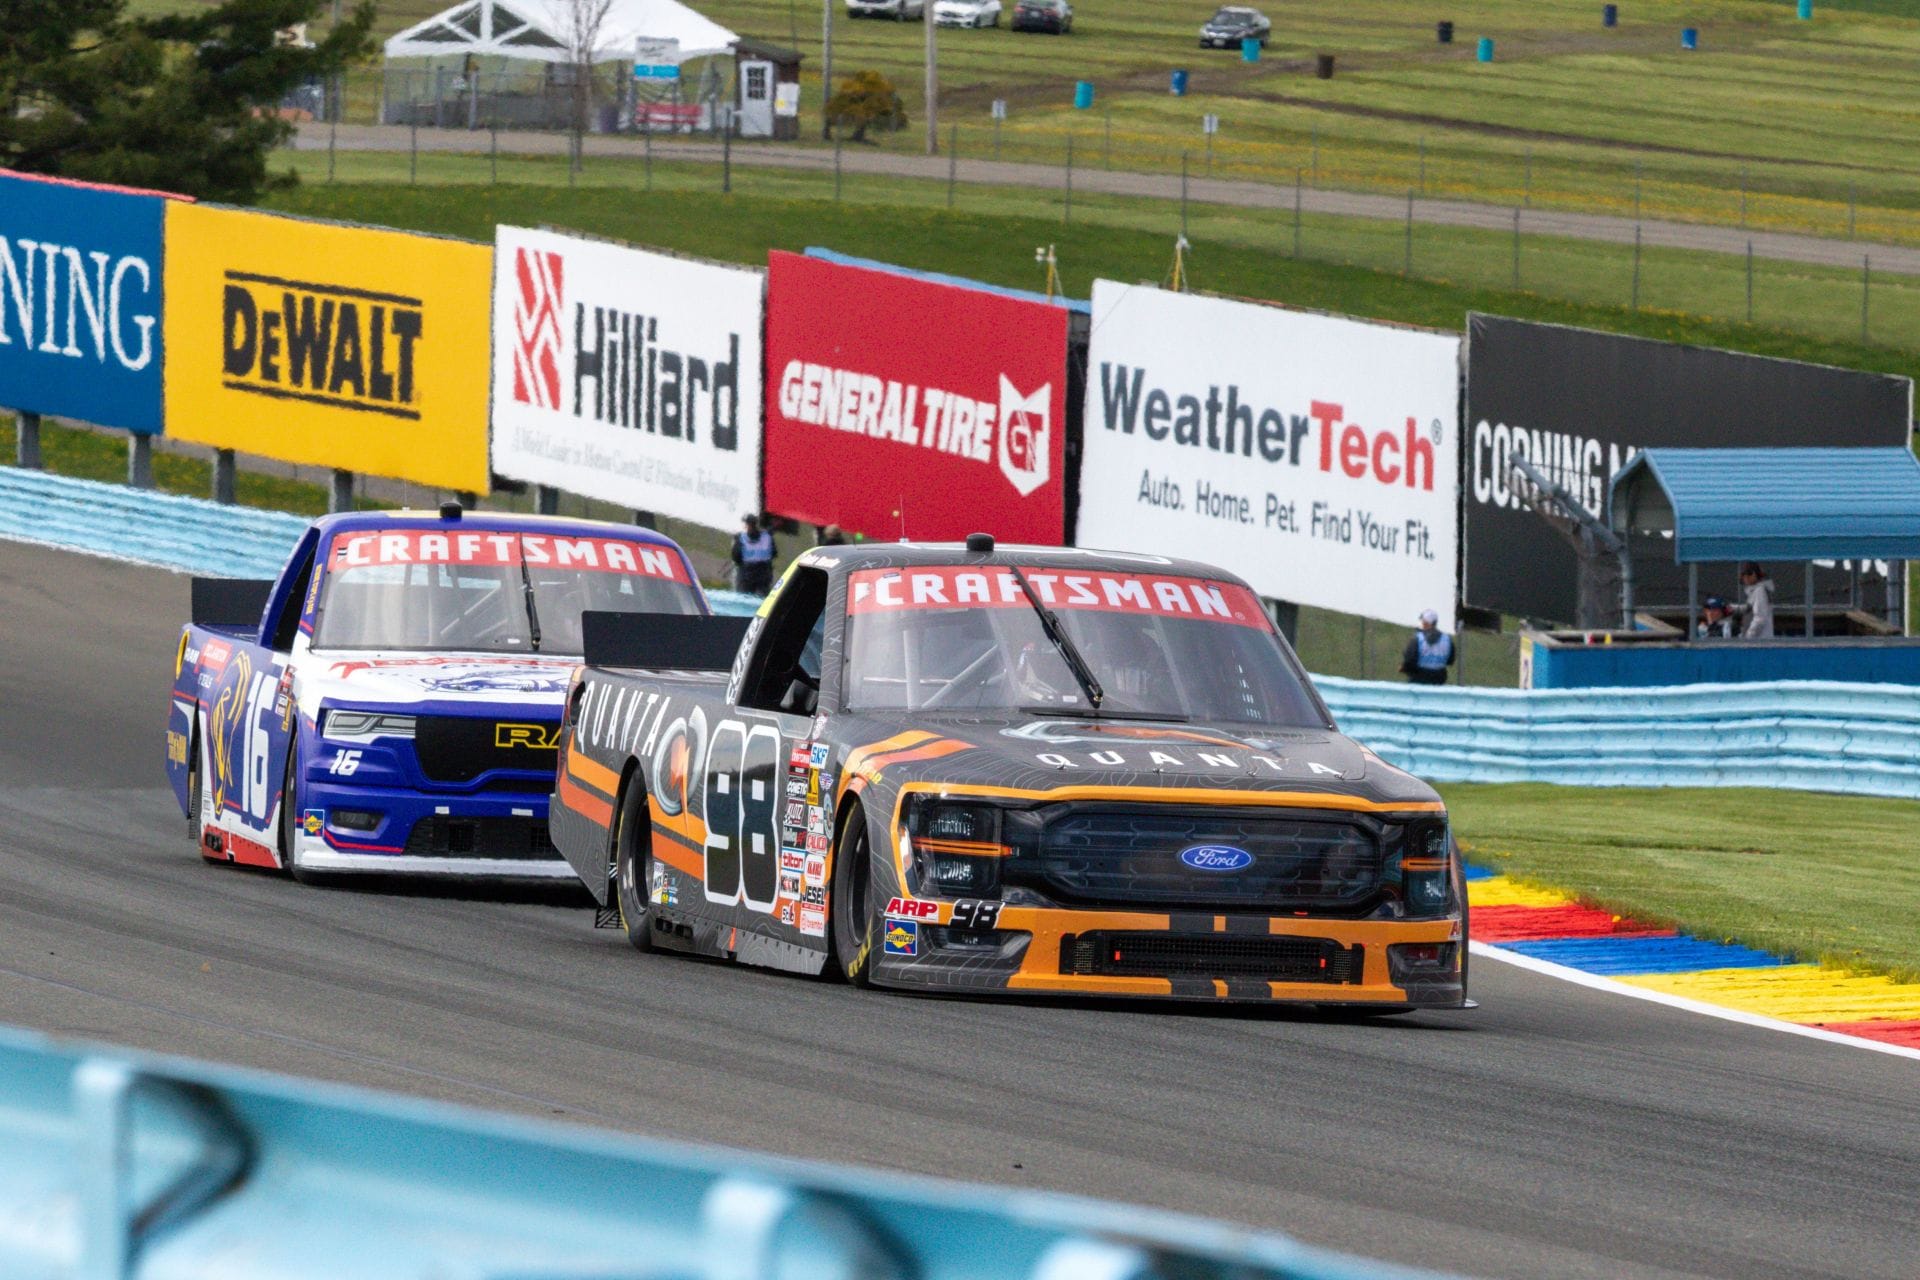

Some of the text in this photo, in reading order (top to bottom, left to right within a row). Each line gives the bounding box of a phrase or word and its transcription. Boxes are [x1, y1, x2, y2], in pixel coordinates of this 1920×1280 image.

[575, 303, 738, 451] Hilliard
[780, 359, 998, 464] GENERAL TIRE
[1473, 420, 1602, 520] CORNING
[1138, 469, 1435, 561] Auto. Home. Pet. Find Your Fit.
[346, 534, 674, 579] CRAFTSMAN
[875, 572, 1231, 617] CRAFTSMAN
[577, 681, 671, 756] QUANTA
[243, 671, 278, 819] 16
[811, 747, 828, 764] SKF
[329, 748, 363, 776] 16
[1035, 750, 1345, 779] QUANTA
[704, 719, 780, 914] 98
[806, 834, 828, 850] CALICO
[782, 852, 803, 870] tilton
[1192, 848, 1240, 869] Ford
[802, 885, 826, 906] JESEL
[887, 898, 938, 917] ARP
[949, 898, 1006, 929] 98
[885, 931, 915, 944] SUNOCO
